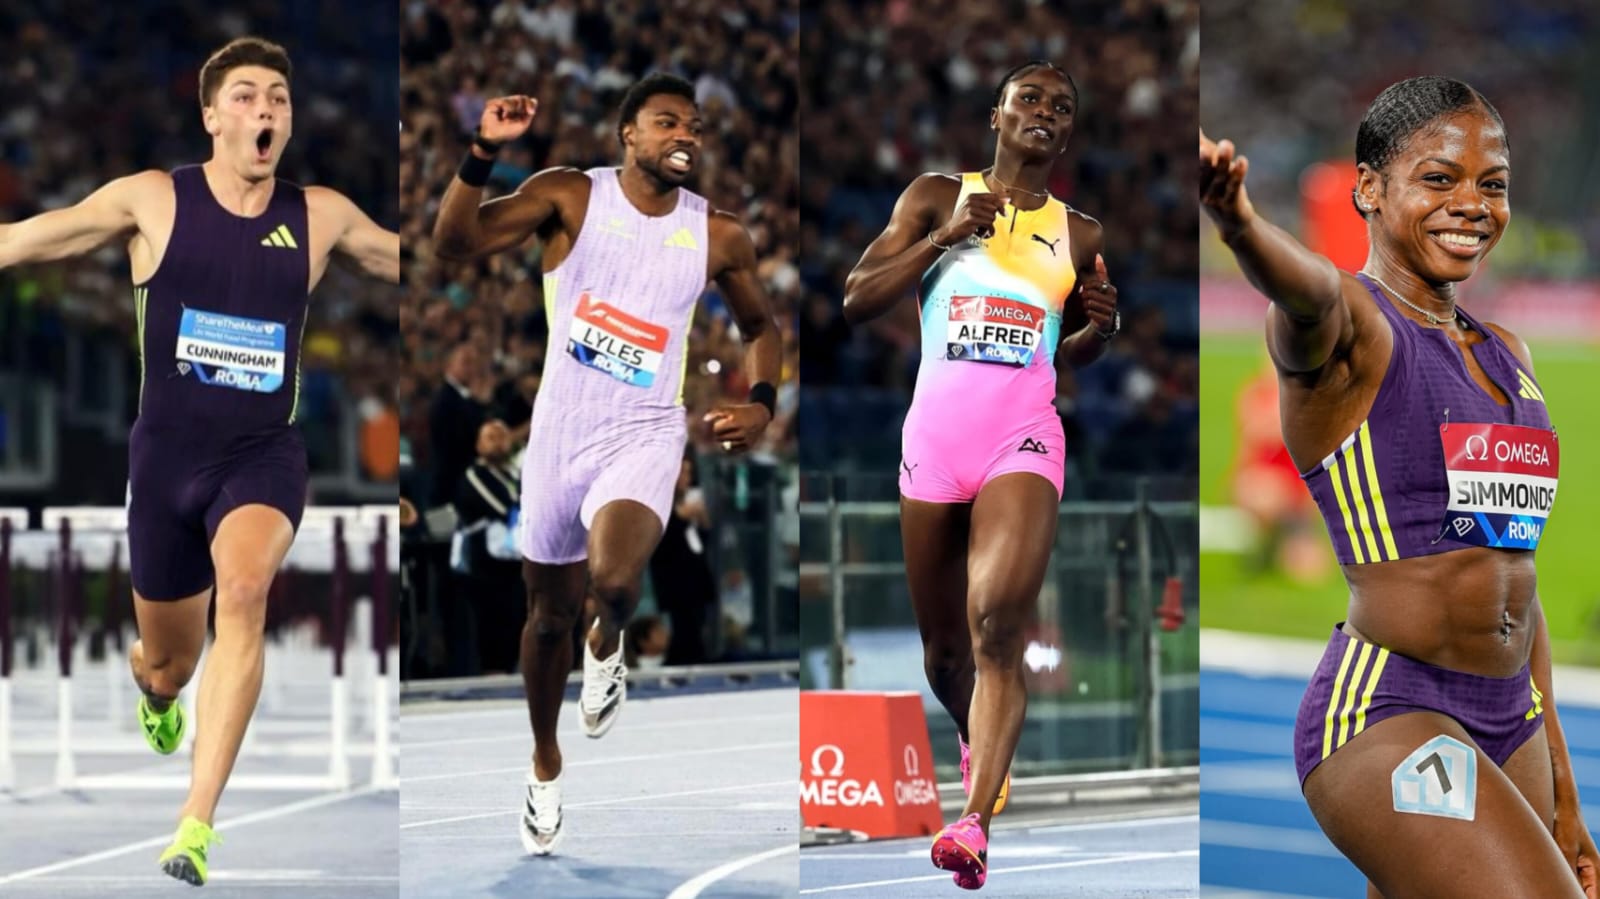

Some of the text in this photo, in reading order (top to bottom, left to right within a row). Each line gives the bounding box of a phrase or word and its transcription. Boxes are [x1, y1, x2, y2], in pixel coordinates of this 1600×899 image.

[983, 304, 1034, 323] OMEGA
[583, 327, 645, 366] LYLES
[958, 325, 1034, 346] ALFRED
[187, 344, 277, 368] CUNNINGHAM
[985, 346, 1021, 360] ROMA
[215, 369, 261, 389] ROMA
[593, 354, 634, 381] ROMA
[1494, 440, 1550, 467] OMEGA
[1457, 480, 1554, 512] SIMMONDS
[1416, 752, 1452, 795] 7
[800, 779, 884, 807] MEGA
[894, 779, 937, 806] OMEGA
